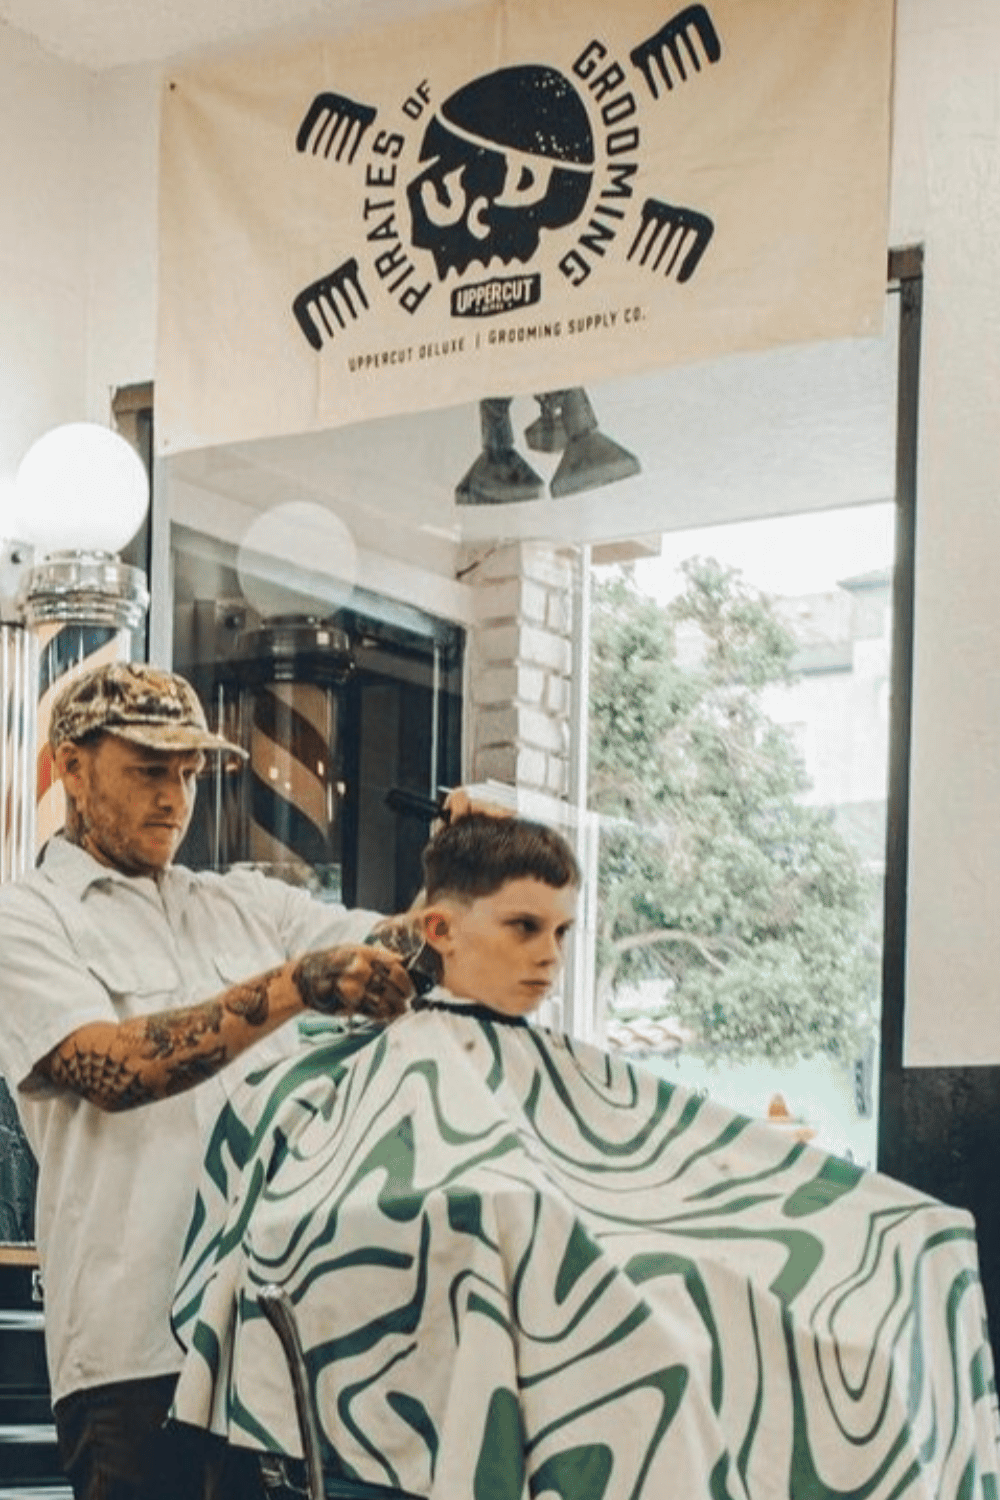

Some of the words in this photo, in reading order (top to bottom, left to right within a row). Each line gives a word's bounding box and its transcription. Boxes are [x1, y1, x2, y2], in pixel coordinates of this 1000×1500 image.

[363, 131, 432, 314] PIRATES
[402, 79, 430, 121] OF
[558, 40, 639, 287] GROOMING
[456, 278, 534, 314] UPPERCUT
[348, 347, 412, 372] UPPERCUT
[419, 337, 464, 360] DELUXE
[488, 321, 561, 344] GROOMING
[568, 311, 617, 335] SUPPLY
[624, 306, 646, 323] CO.
